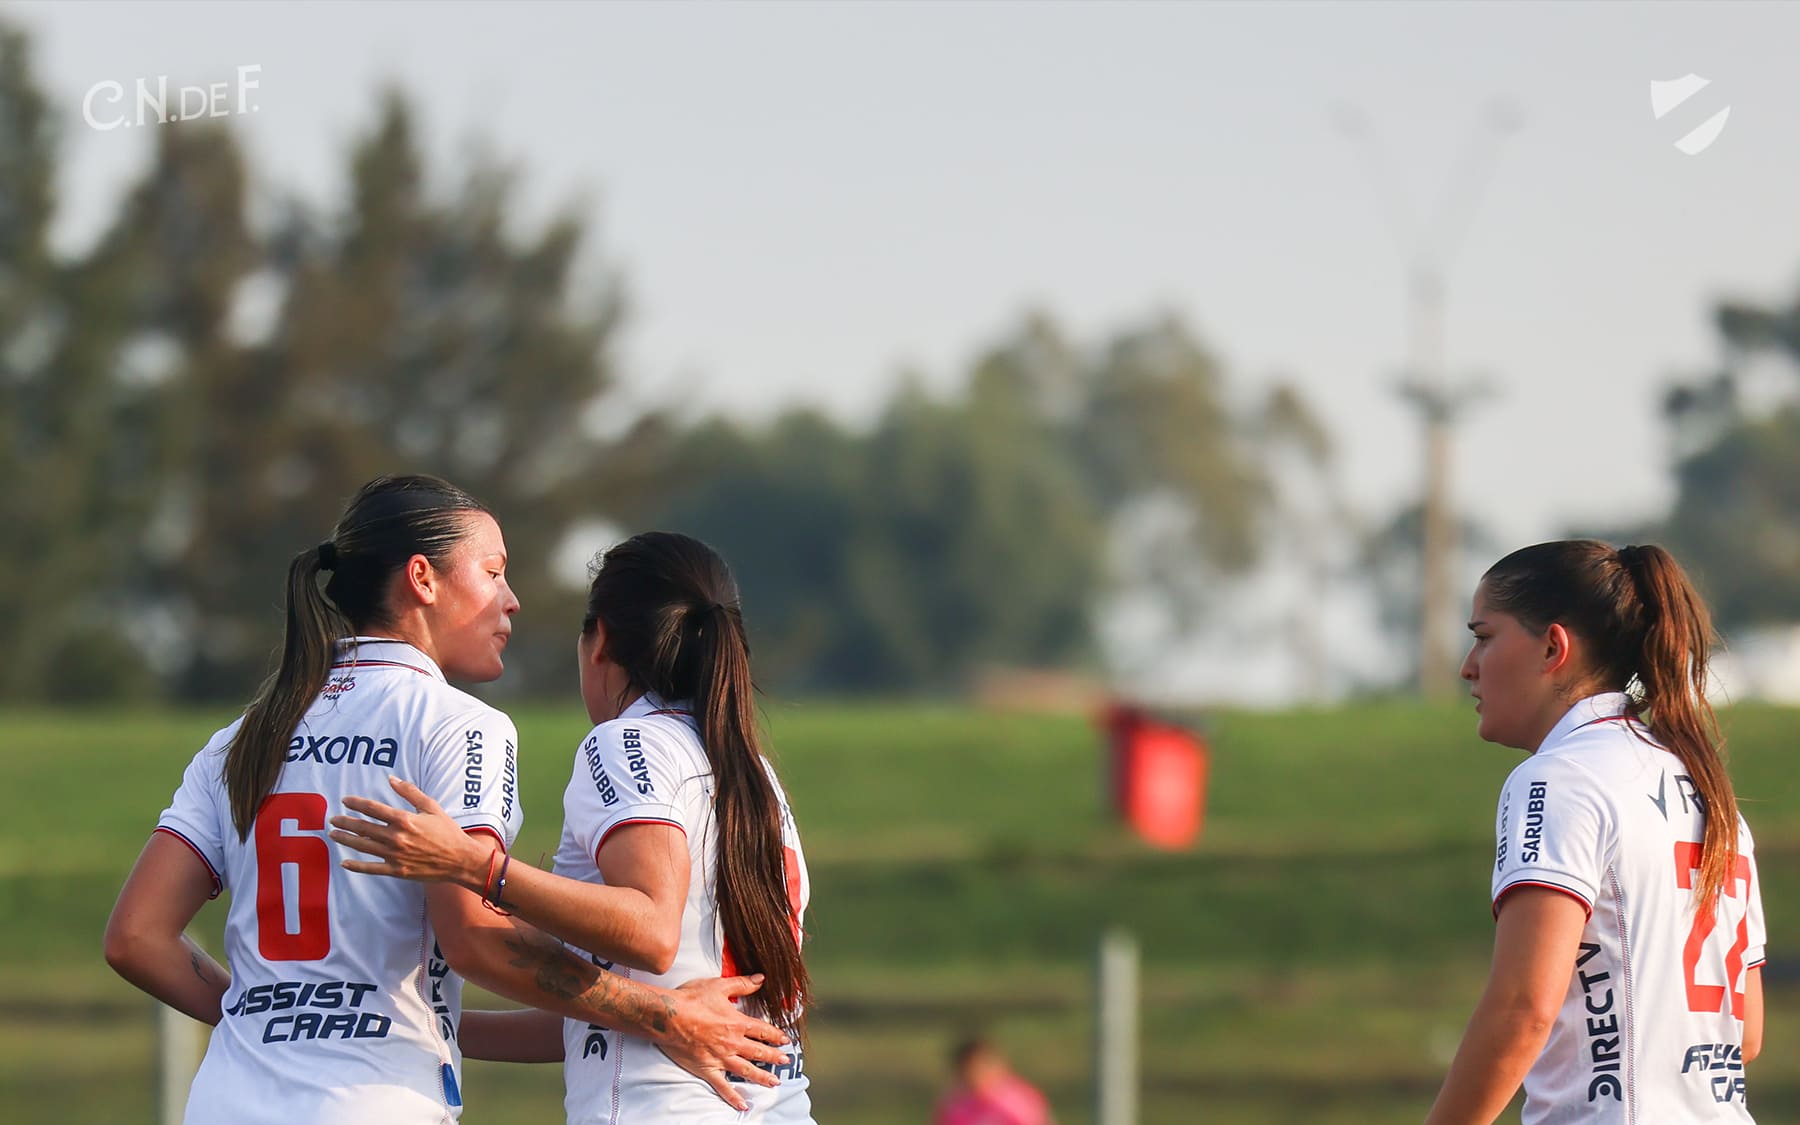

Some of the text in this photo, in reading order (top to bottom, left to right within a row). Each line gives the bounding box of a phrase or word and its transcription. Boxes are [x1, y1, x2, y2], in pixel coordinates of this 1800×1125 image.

[284, 735, 398, 768] exona
[463, 730, 482, 810] SARUBBI
[502, 739, 514, 823] SARUBBI
[585, 735, 619, 807] SARUBBI
[624, 729, 655, 795] SARUBBI
[1521, 781, 1547, 863] SARUBBI
[255, 792, 331, 961] 6
[1674, 840, 1752, 1022] 22
[226, 981, 378, 1017] ASSIST
[262, 1012, 392, 1044] CARD
[1576, 942, 1622, 1102] DIRECTV
